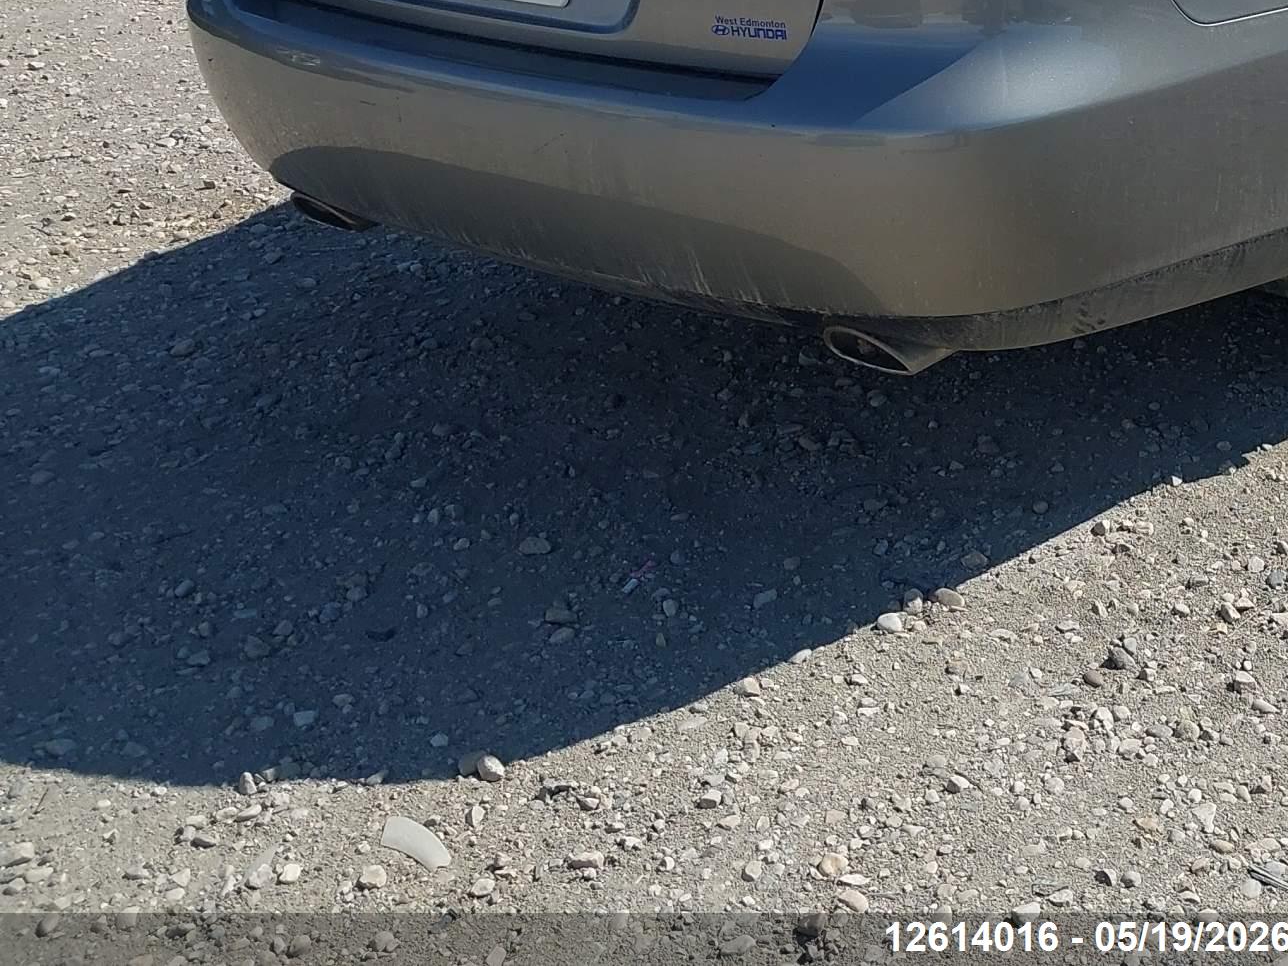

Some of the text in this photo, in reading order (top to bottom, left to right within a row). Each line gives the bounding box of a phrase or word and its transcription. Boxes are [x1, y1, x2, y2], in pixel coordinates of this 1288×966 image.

[715, 15, 786, 28] West Edmonton
[731, 26, 787, 40] HYUNDAI
